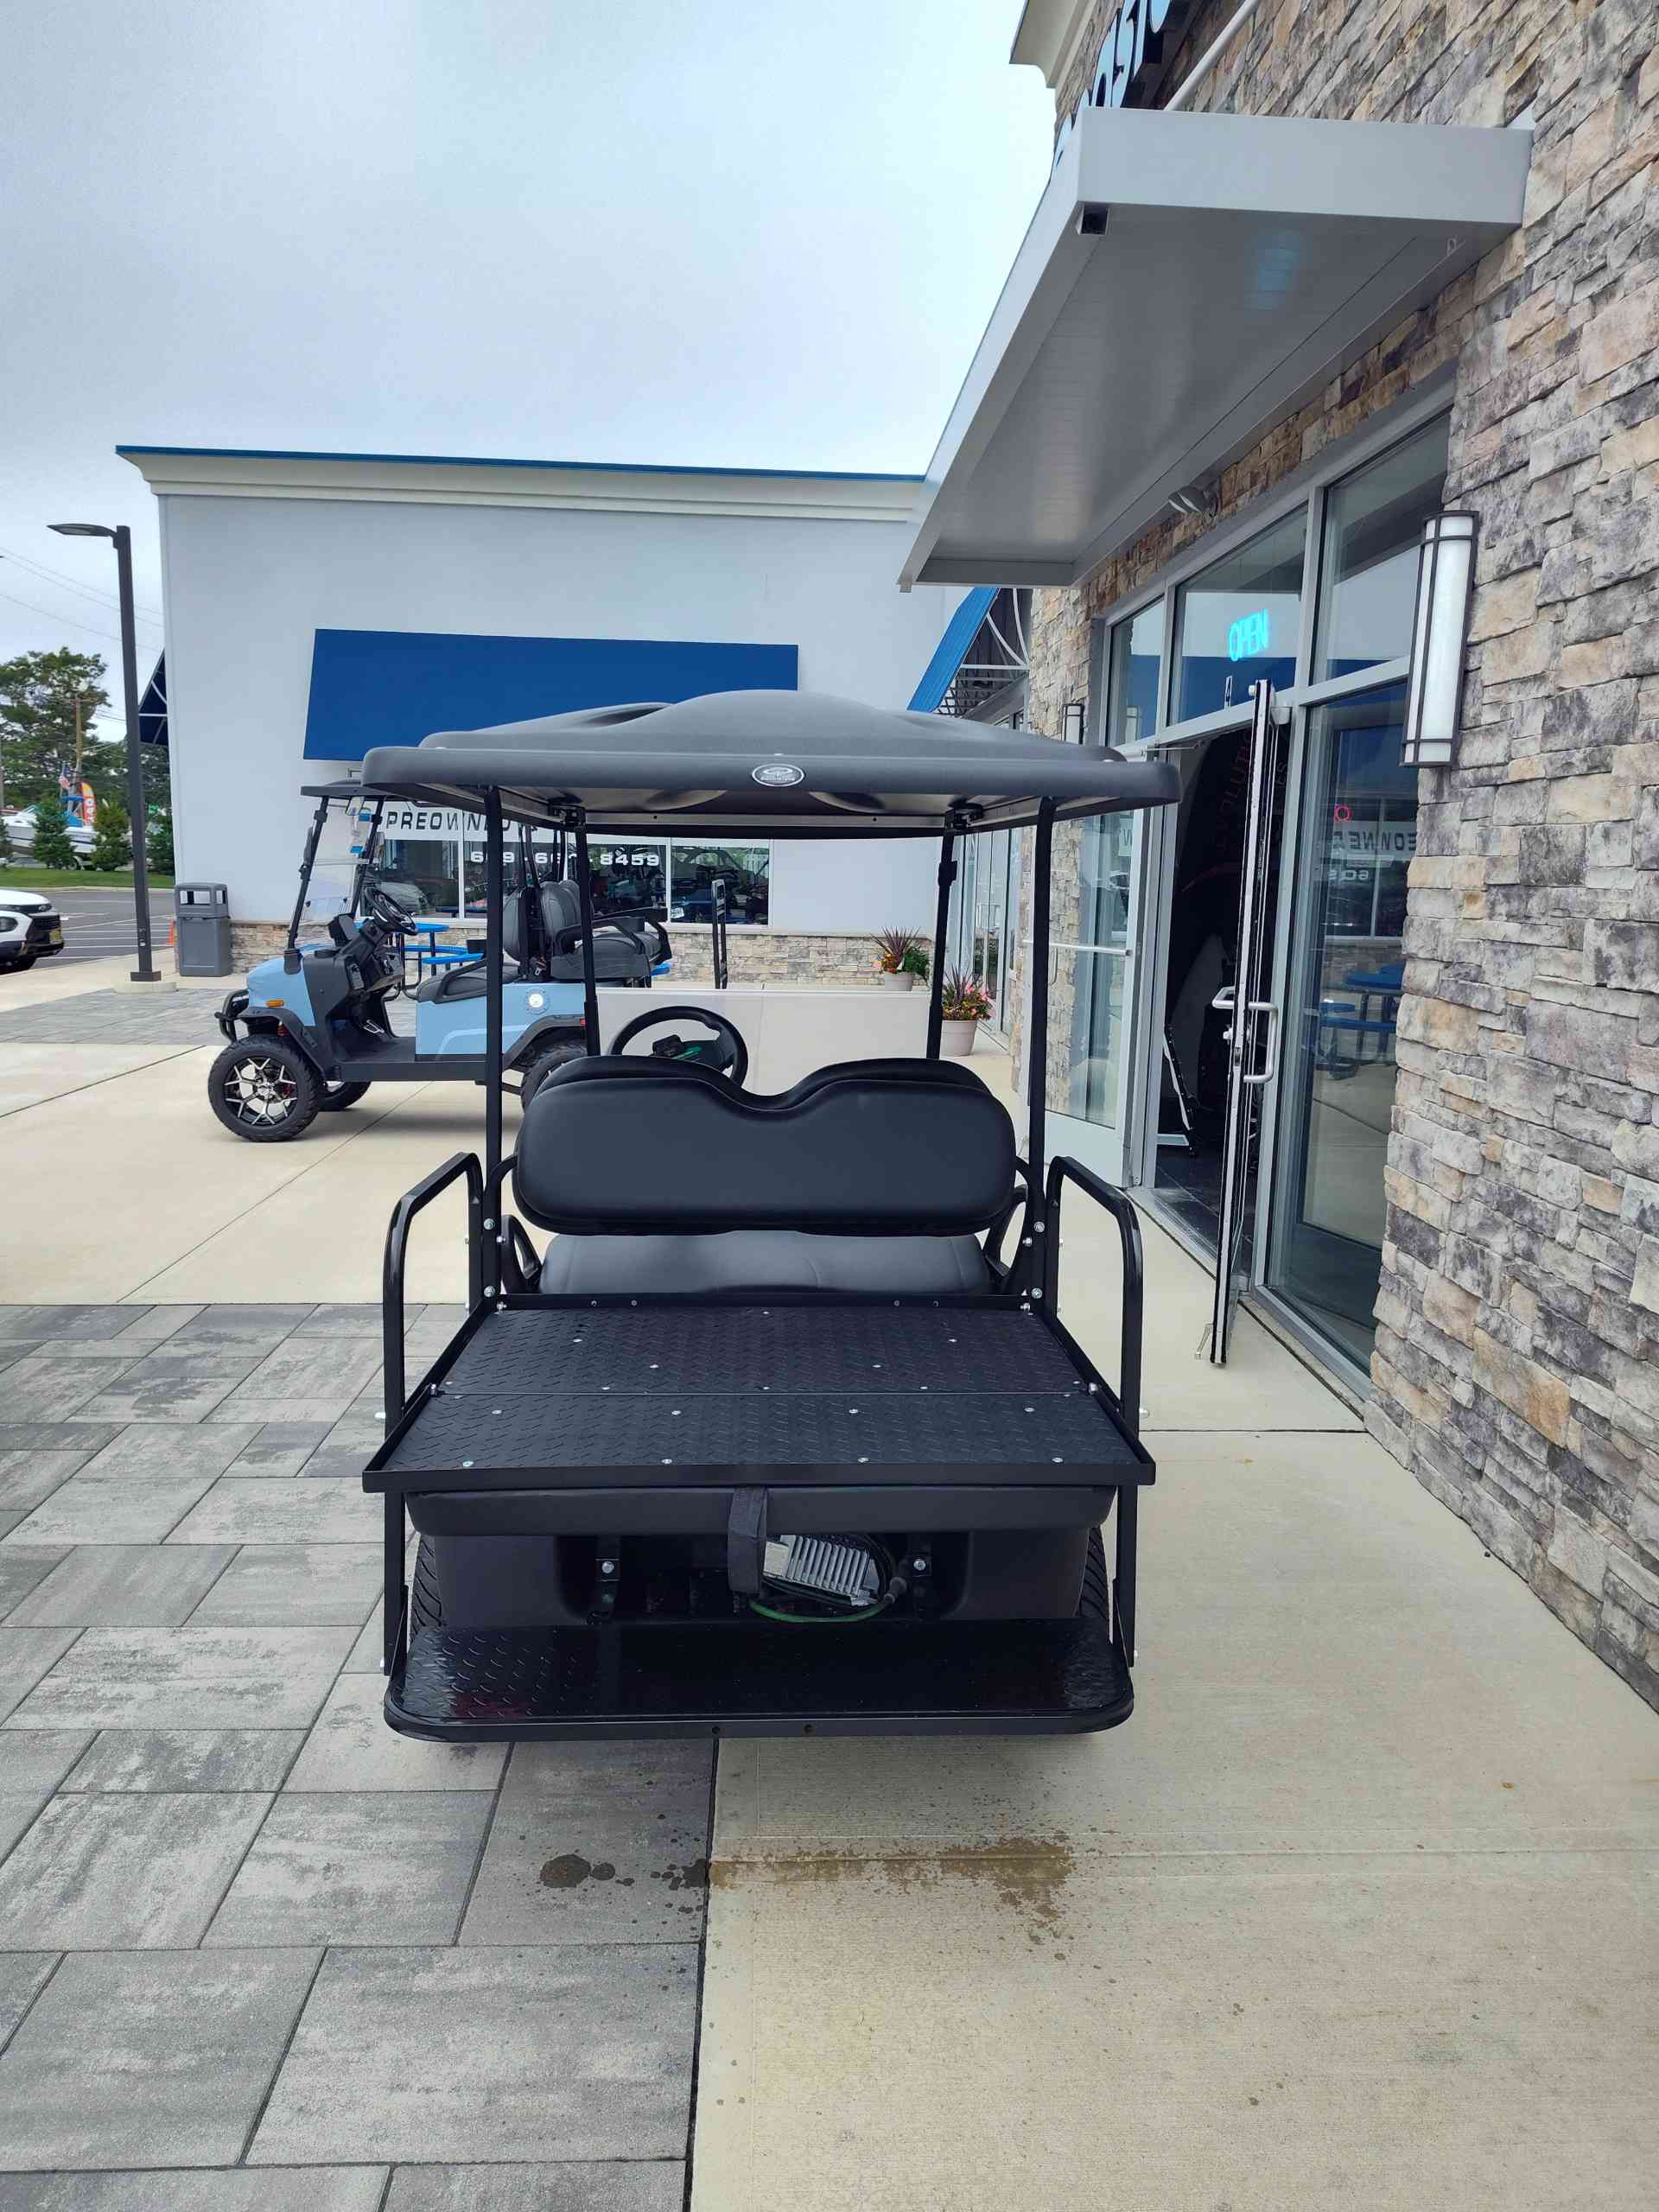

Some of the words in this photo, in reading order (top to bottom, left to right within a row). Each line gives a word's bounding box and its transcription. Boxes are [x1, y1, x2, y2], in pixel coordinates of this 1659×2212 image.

[1229, 607, 1268, 662] OPEN
[386, 810, 512, 831] PREOWND
[470, 851, 515, 863] 69
[600, 852, 659, 866] 8459
